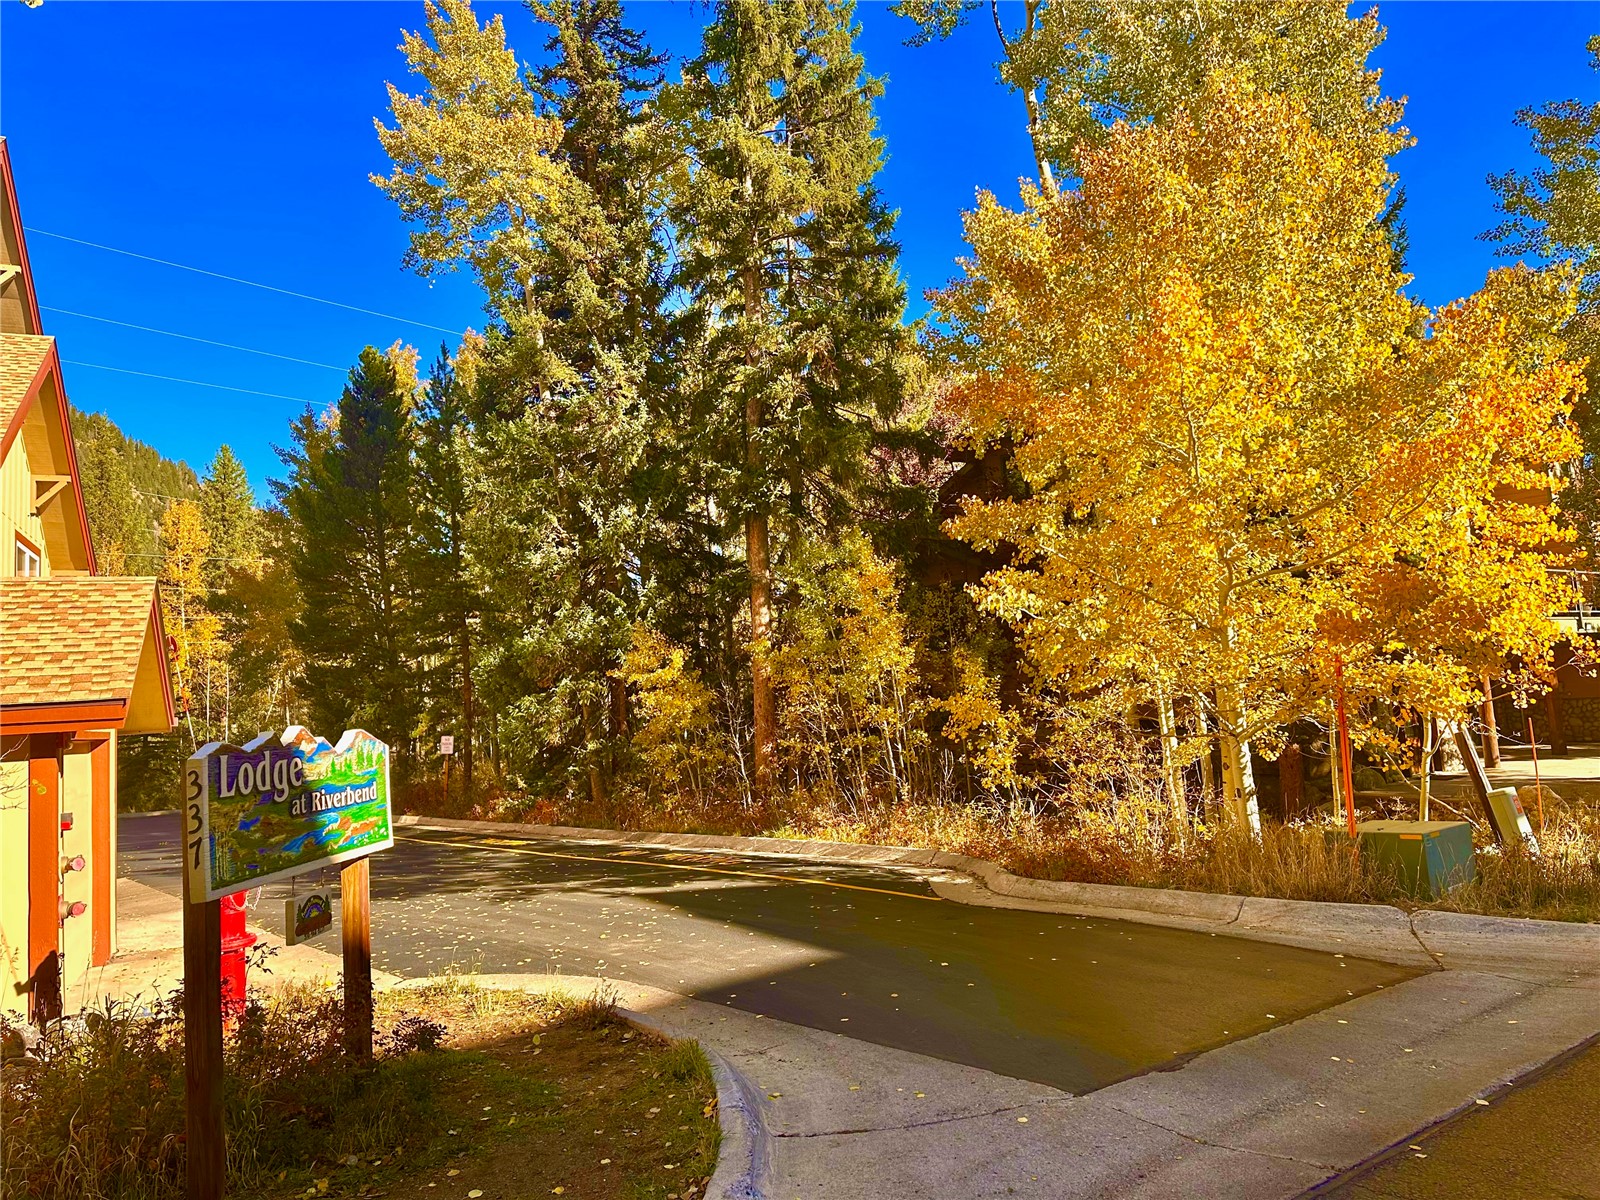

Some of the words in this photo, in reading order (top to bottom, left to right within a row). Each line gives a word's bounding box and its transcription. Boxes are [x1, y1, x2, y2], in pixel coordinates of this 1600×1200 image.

[219, 750, 304, 803] Lodge
[291, 798, 307, 816] at
[311, 781, 378, 812] Riverbend
[187, 769, 202, 870] 337
